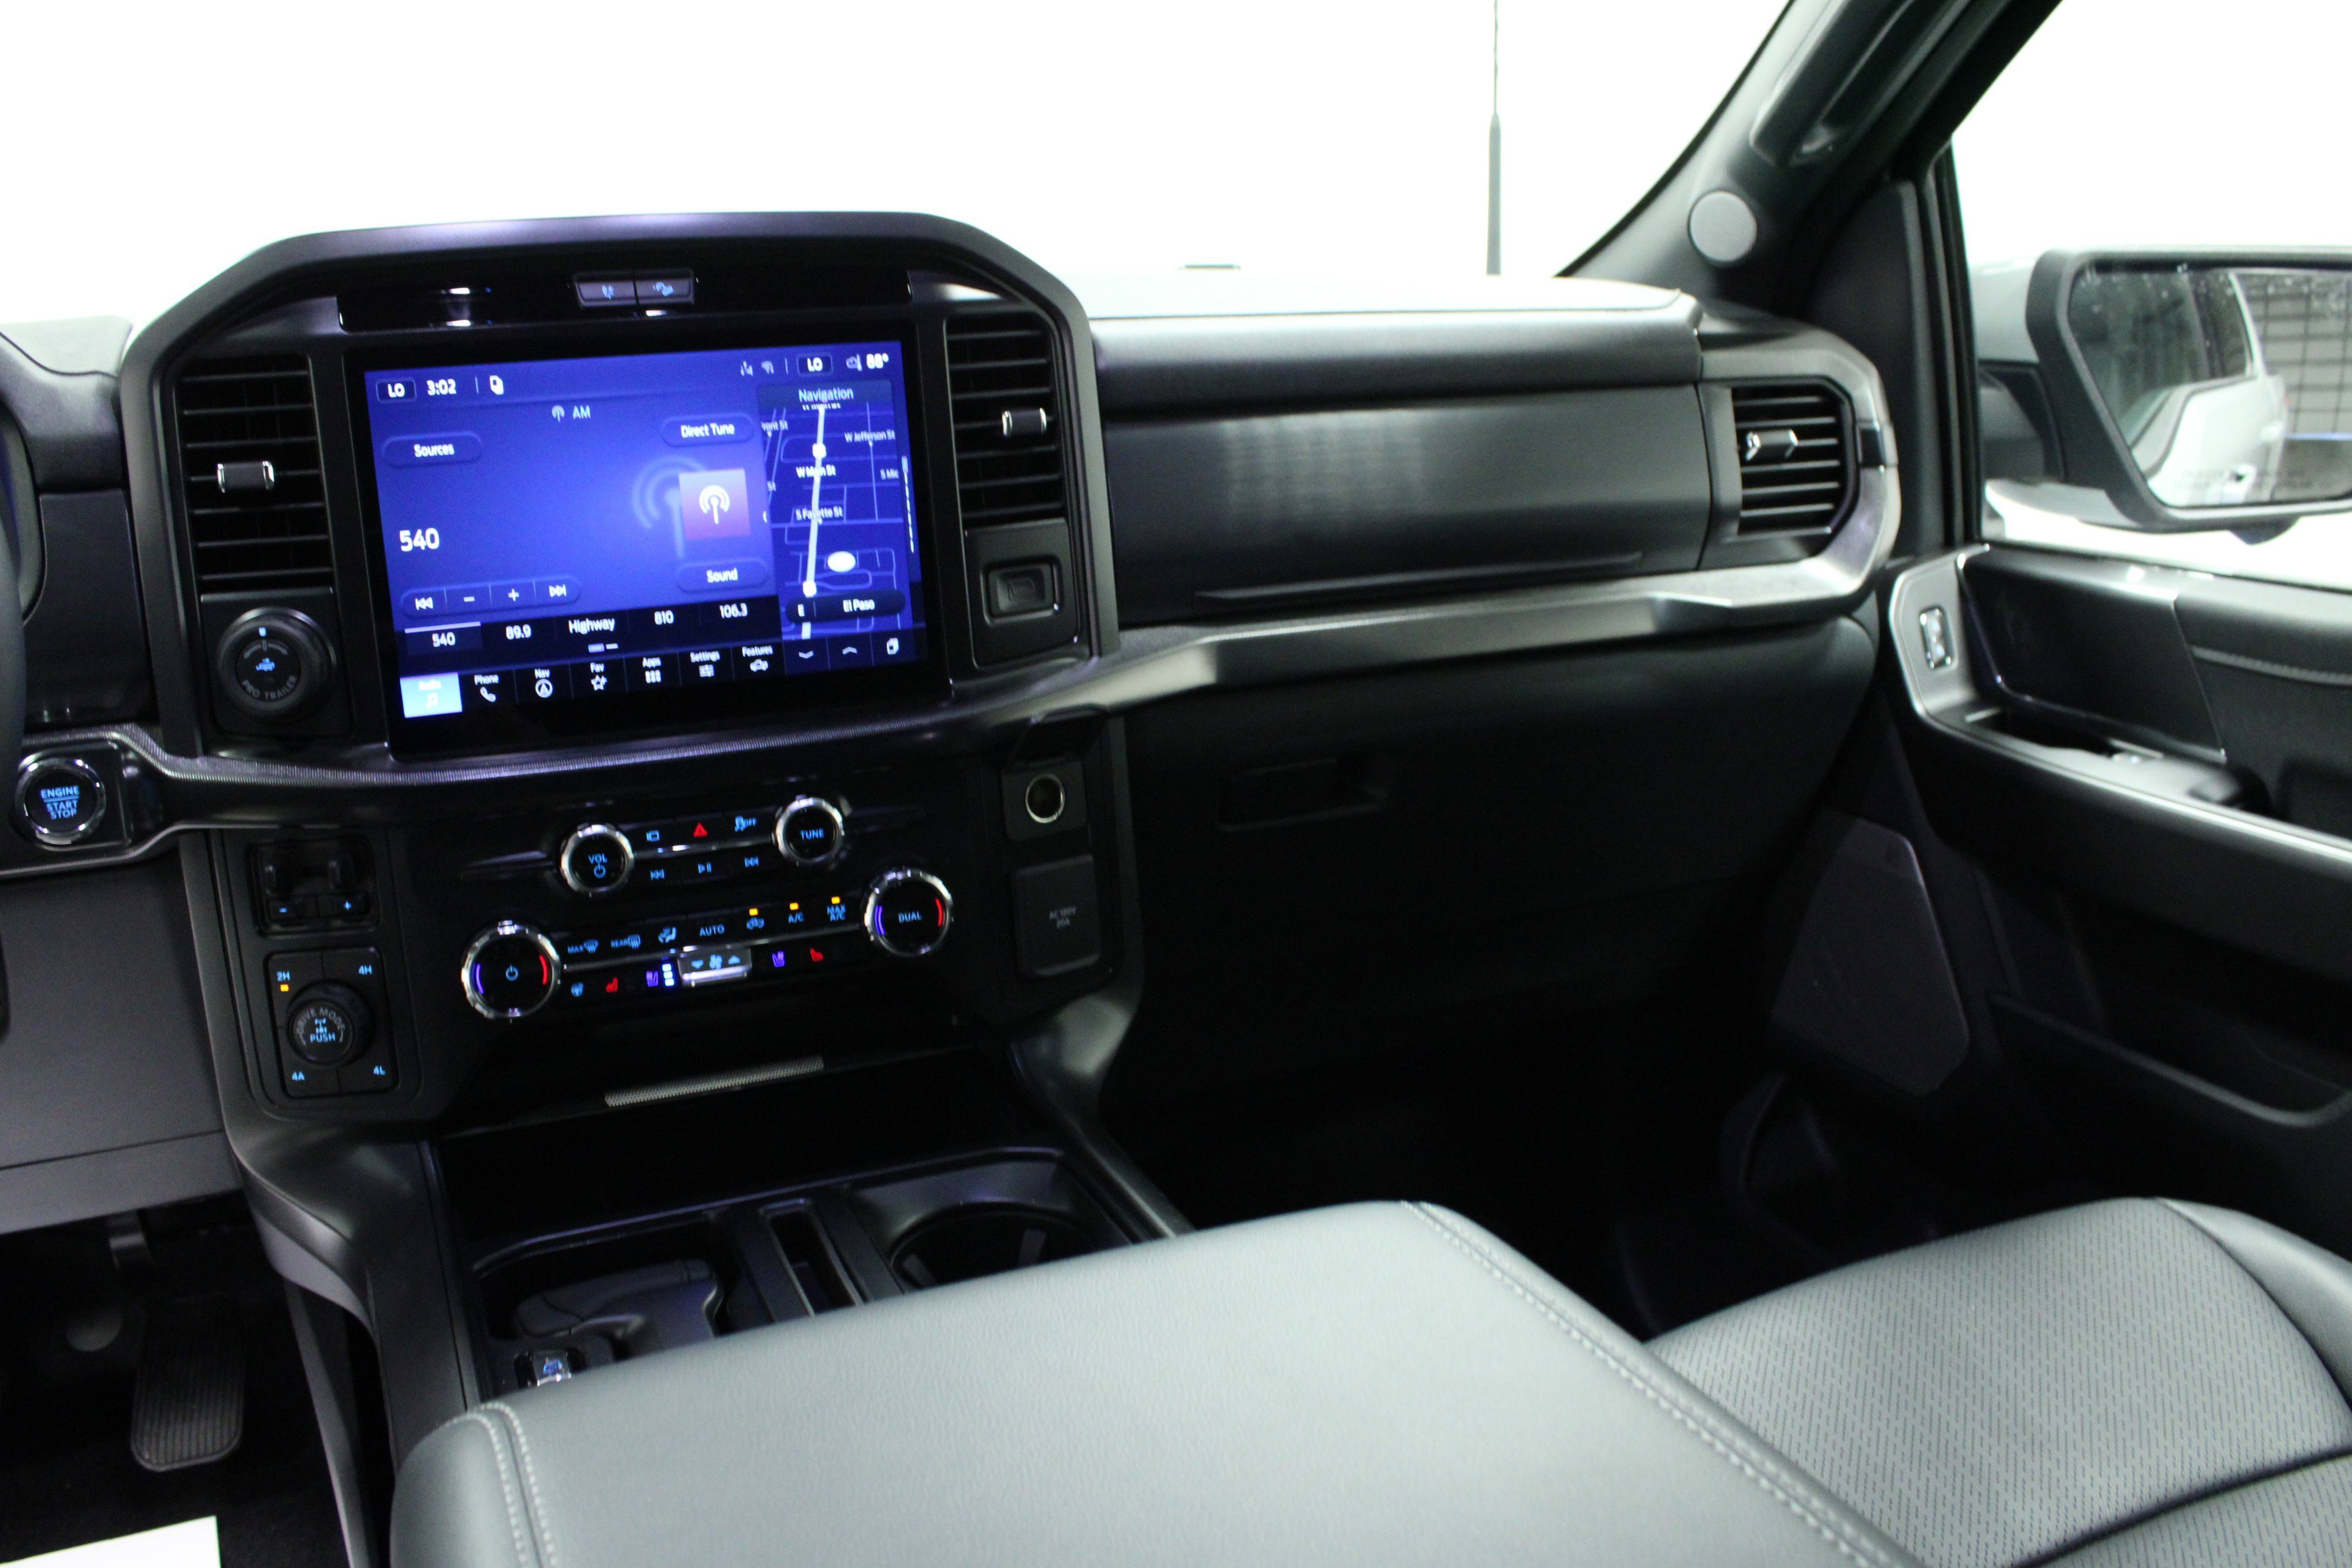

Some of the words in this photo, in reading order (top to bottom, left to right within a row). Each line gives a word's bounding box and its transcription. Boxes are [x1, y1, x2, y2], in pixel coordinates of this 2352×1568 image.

[807, 357, 823, 372] LO
[388, 383, 405, 398] LO
[427, 378, 456, 396] 3:02
[799, 387, 854, 403] Navigation
[572, 406, 591, 419] AM
[681, 424, 710, 438] Direct
[710, 423, 735, 436] Tune
[414, 443, 454, 458] Sources
[399, 527, 440, 552] 540
[707, 568, 738, 583] Sound
[568, 618, 615, 635] Highway
[432, 632, 455, 647] 540
[690, 651, 720, 663] Settings
[534, 668, 550, 678] Nav
[474, 674, 499, 685] Phone
[40, 785, 80, 799] ENGINE
[46, 799, 78, 812] START
[51, 809, 77, 820] STOP
[800, 828, 825, 840] TUNE
[588, 852, 607, 864] VOL
[788, 912, 804, 923] A/C
[898, 911, 922, 923] DUAL
[699, 924, 725, 937] AUTO
[567, 945, 584, 954] MAX
[358, 965, 373, 975] 4H
[277, 971, 290, 982] 2H
[310, 1032, 336, 1043] PUSH
[292, 1071, 305, 1081] 4A
[373, 1065, 386, 1075] 4L
